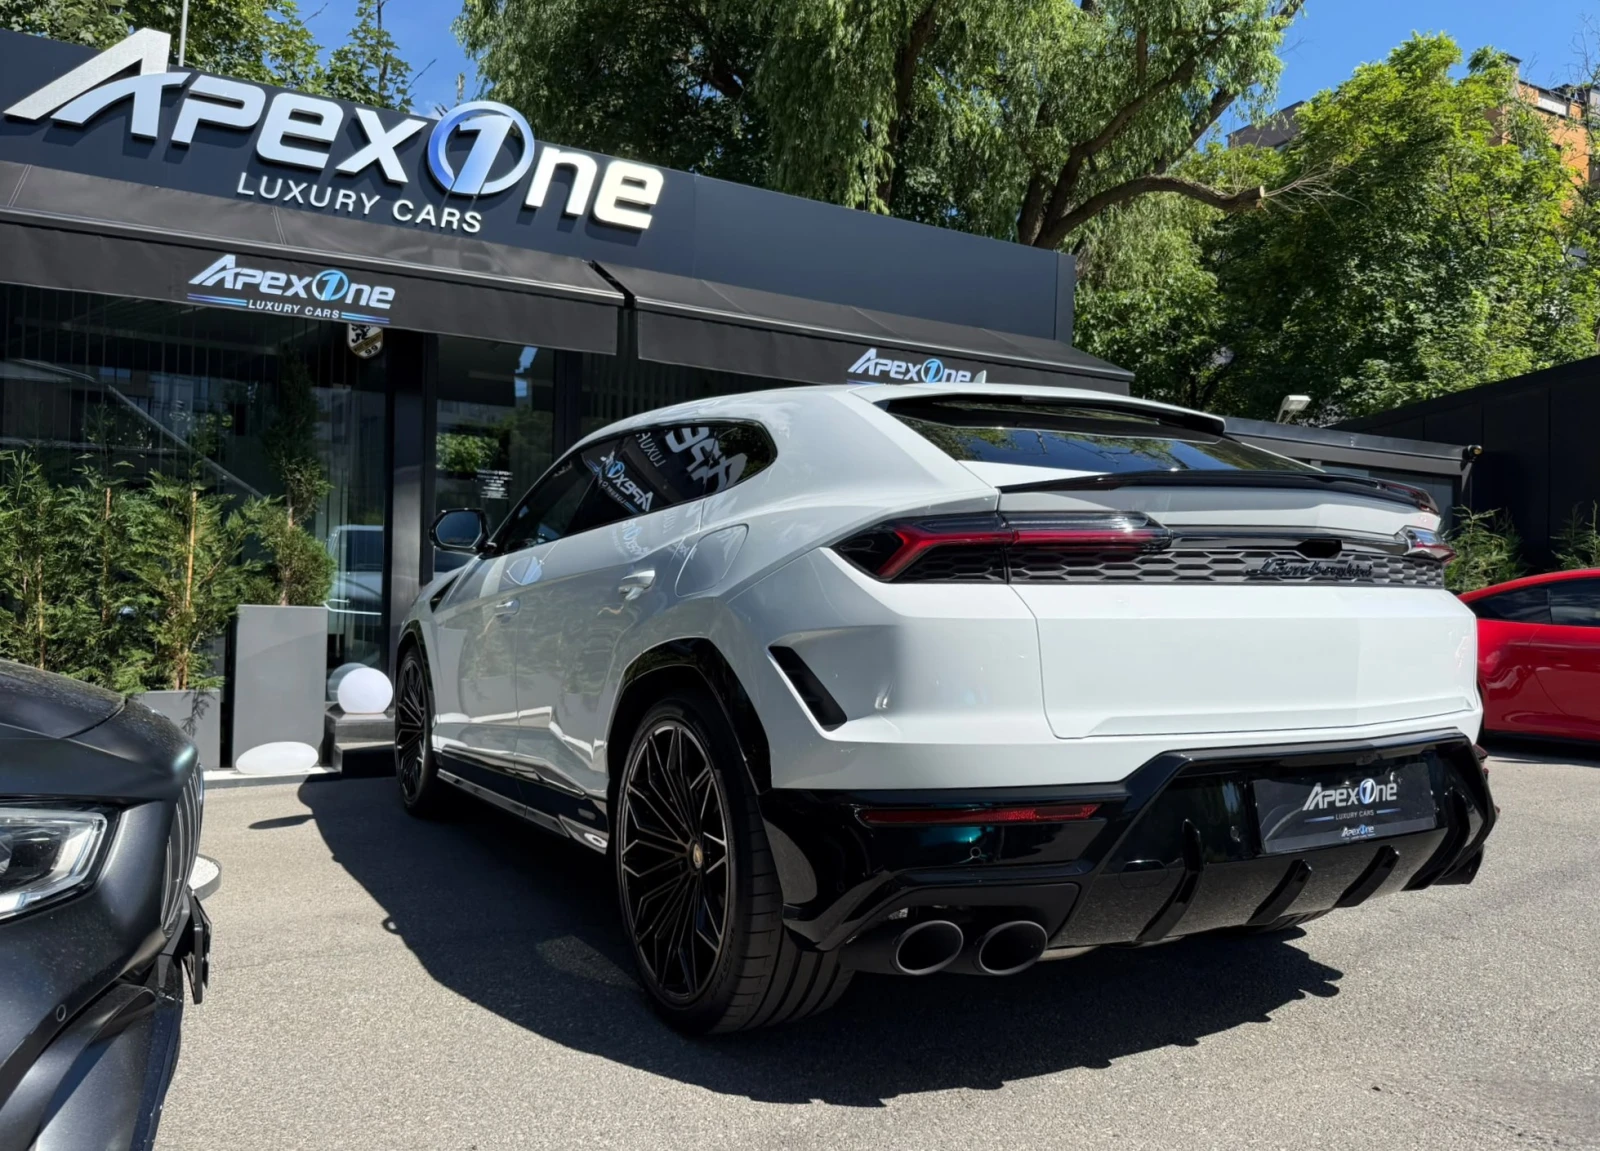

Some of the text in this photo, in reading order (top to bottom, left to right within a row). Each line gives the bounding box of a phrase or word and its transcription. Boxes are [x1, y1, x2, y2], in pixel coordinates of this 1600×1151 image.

[236, 172, 482, 233] LUXURY CARS
[248, 299, 340, 319] LUXURY CARS
[1246, 557, 1373, 580] Lamborghini
[1335, 810, 1375, 821] LUXURY CARS
